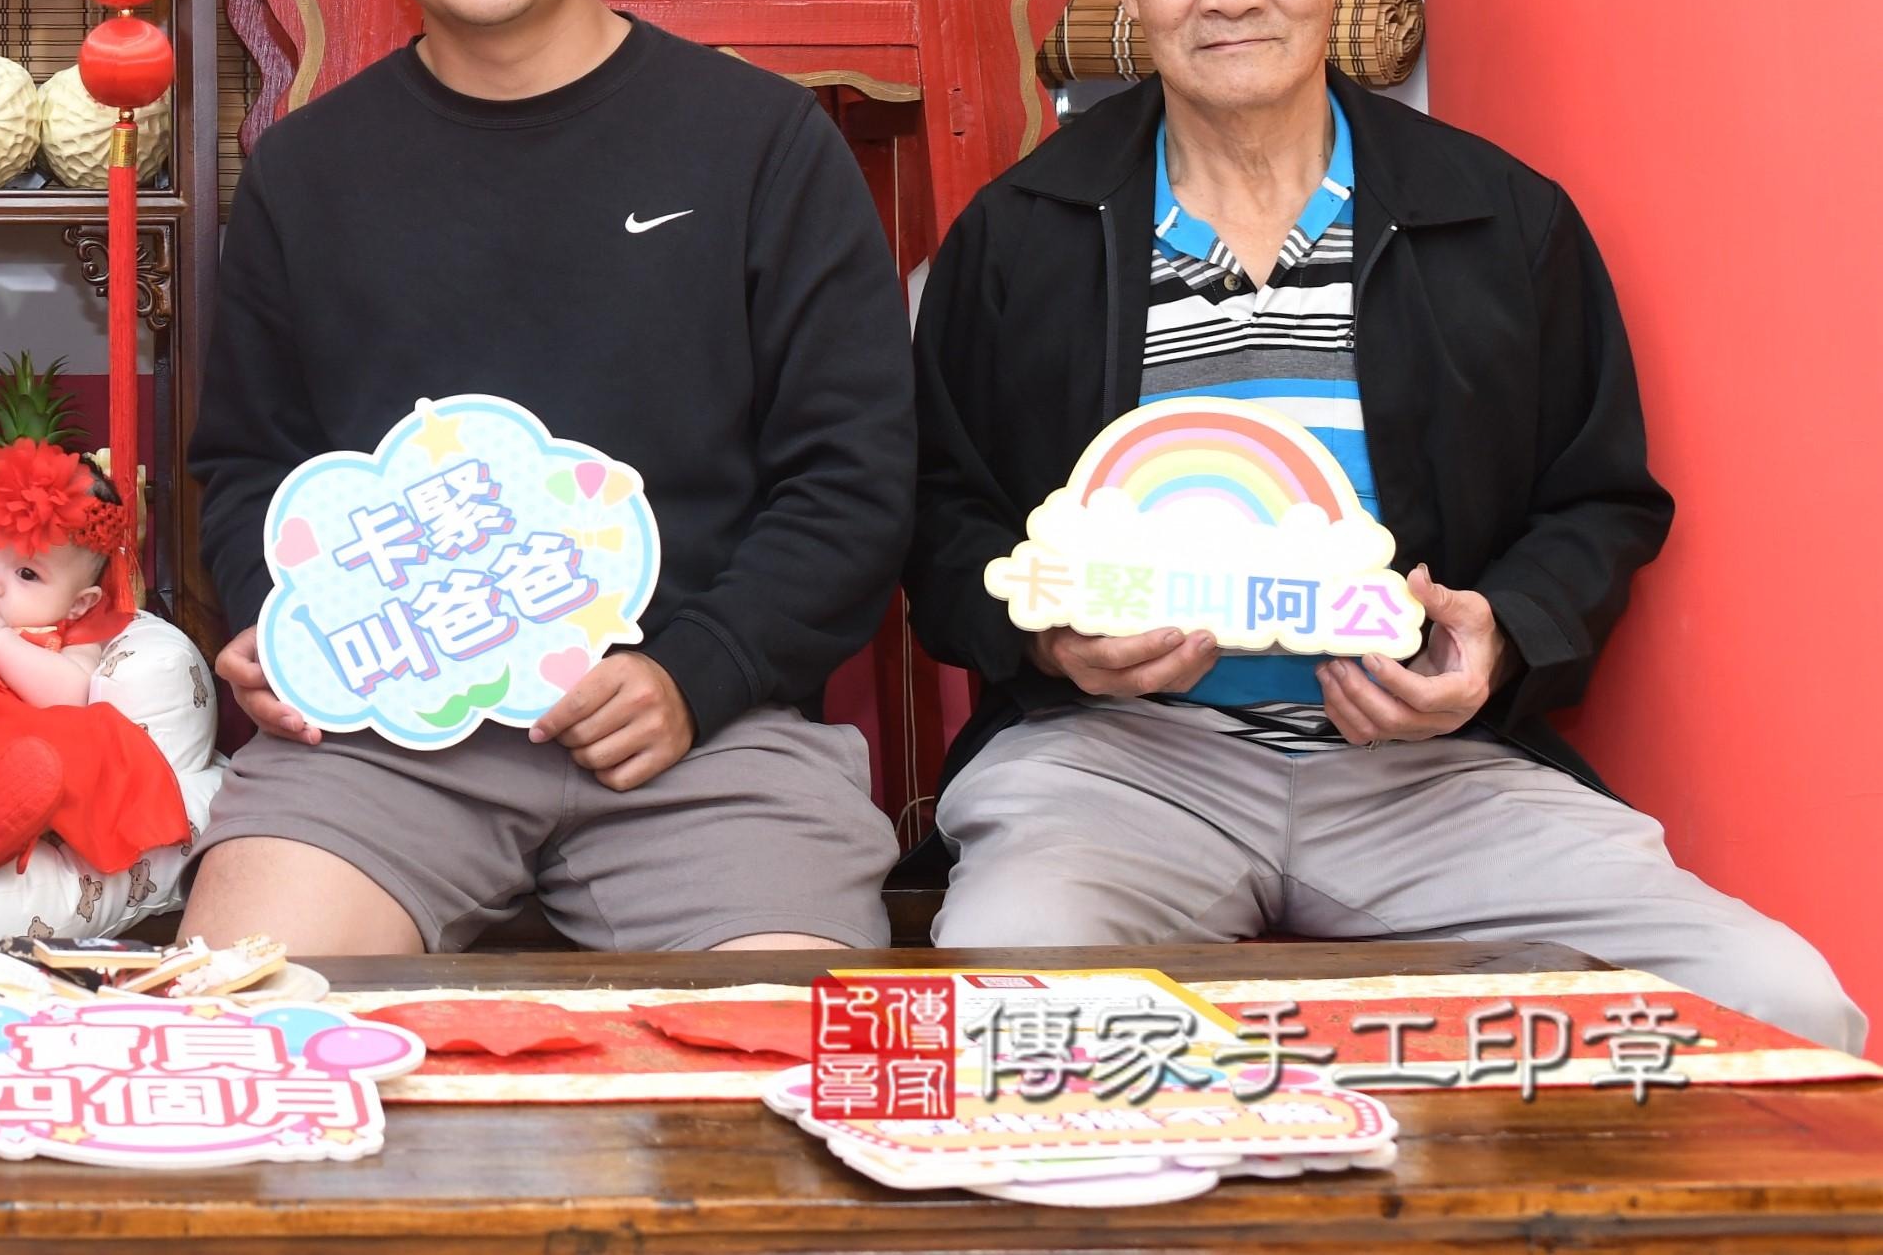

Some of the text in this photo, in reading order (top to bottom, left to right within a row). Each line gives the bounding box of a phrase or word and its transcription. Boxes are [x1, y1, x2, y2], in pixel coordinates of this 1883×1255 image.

[333, 459, 515, 590] 卡緊
[325, 531, 598, 693] 叫爸爸
[1003, 556, 1404, 641] 卡緊叫阿公
